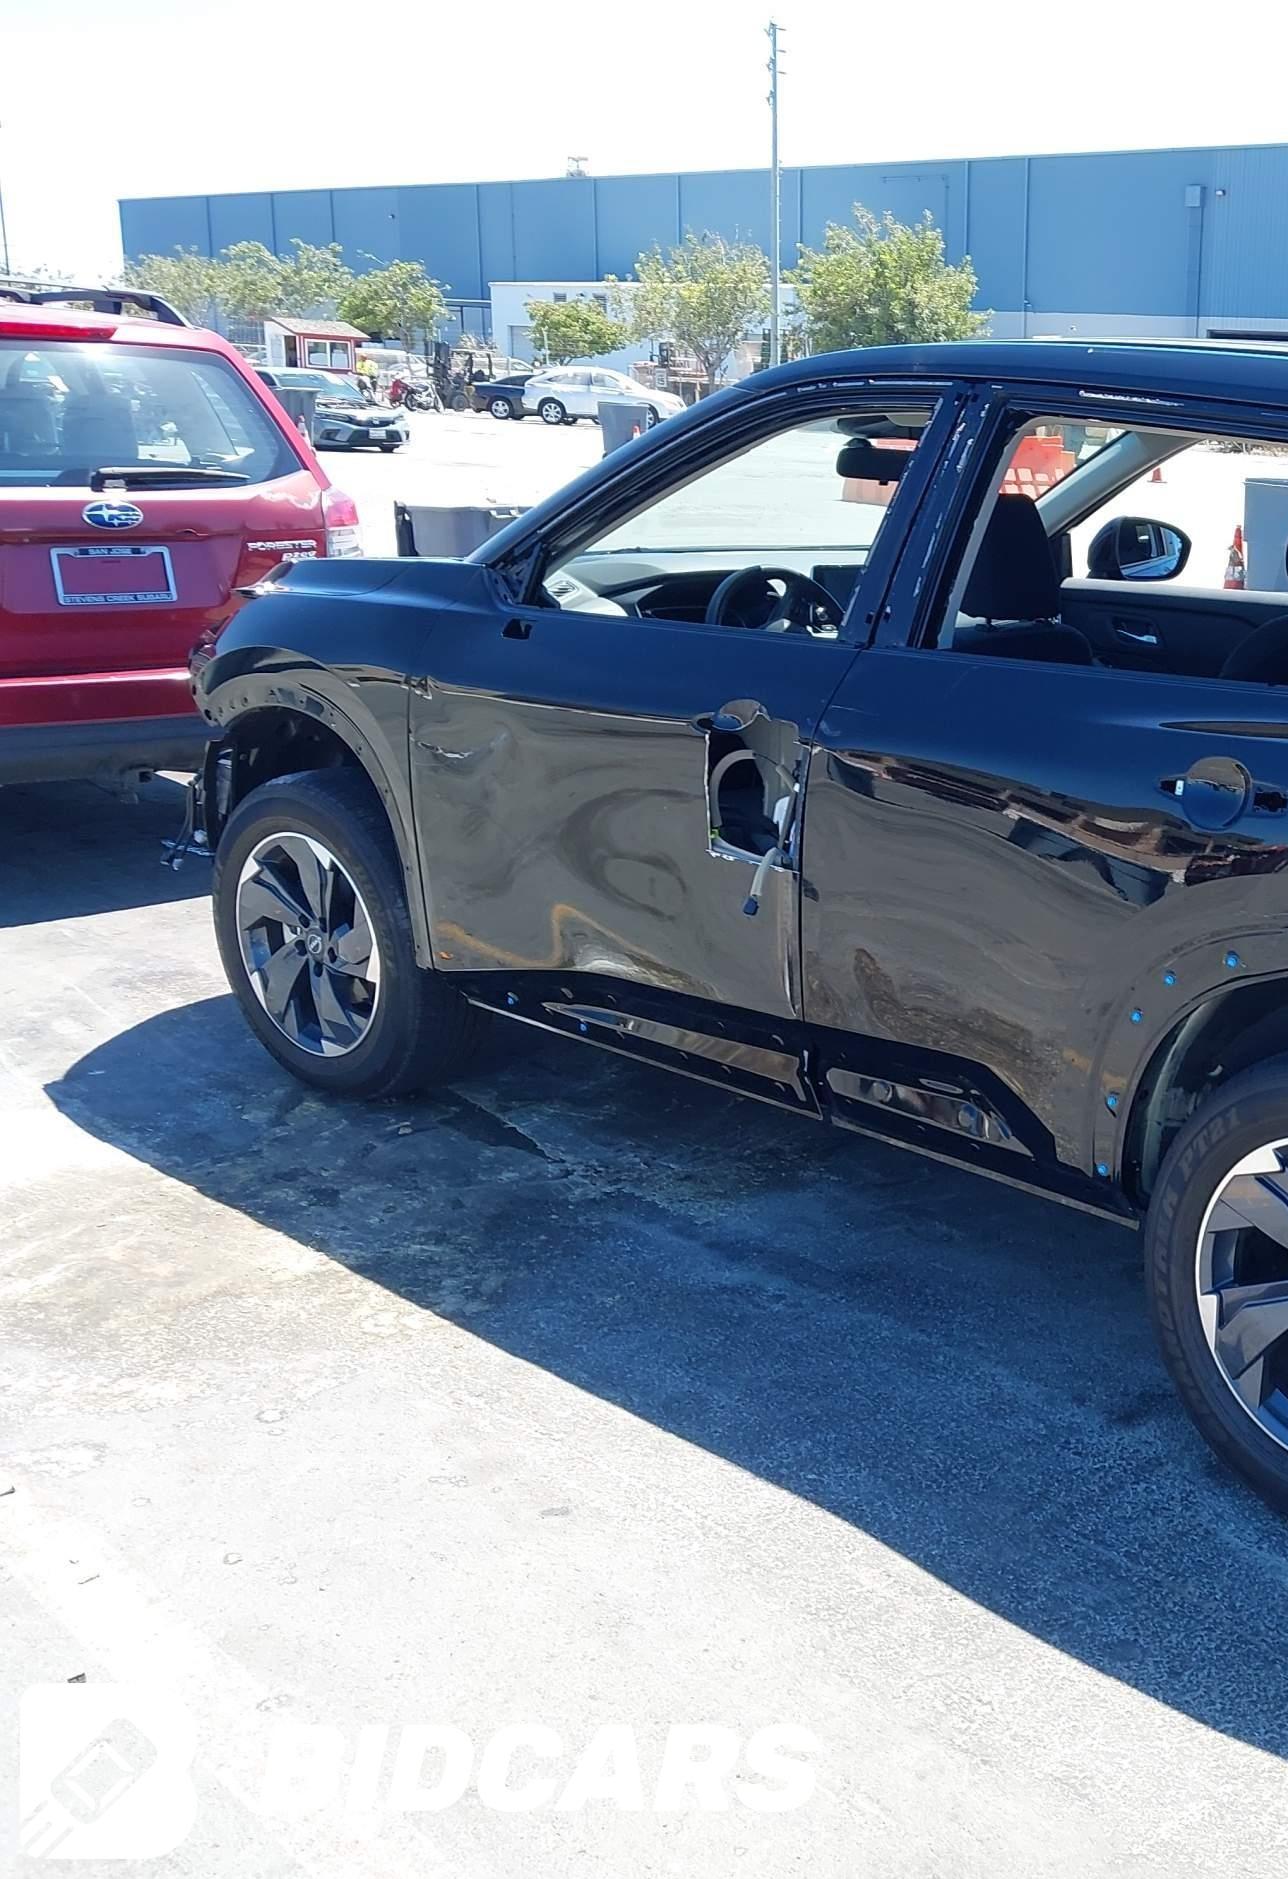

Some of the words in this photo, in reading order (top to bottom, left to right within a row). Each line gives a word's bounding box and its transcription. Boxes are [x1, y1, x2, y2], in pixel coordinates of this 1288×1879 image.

[246, 539, 317, 551] FORESTER
[136, 592, 172, 601] SUBARU
[1177, 1106, 1242, 1184] PT21
